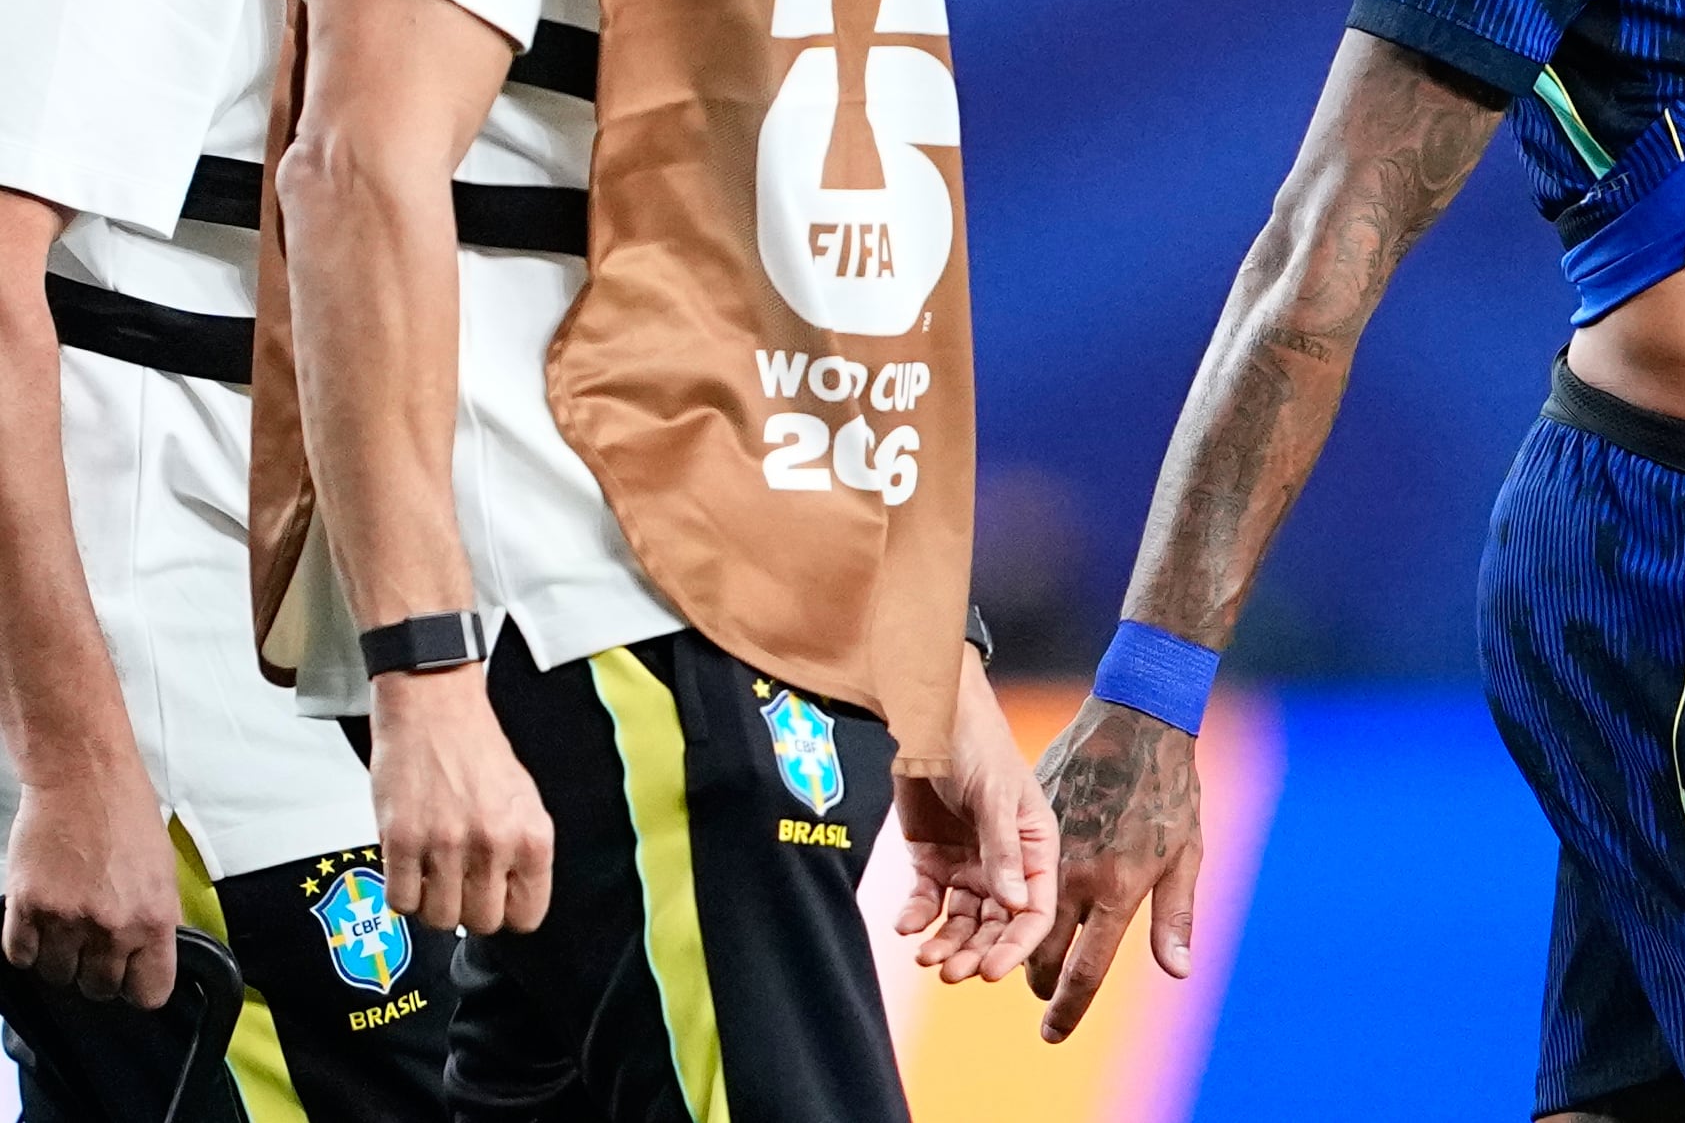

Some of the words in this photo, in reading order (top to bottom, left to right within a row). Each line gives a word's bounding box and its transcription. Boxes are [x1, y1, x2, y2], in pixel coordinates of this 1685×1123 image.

[808, 223, 895, 278] FIFA
[870, 361, 931, 412] CUP
[778, 818, 852, 849] BRASIL
[352, 916, 383, 937] CBF
[349, 989, 428, 1031] BRASIL
